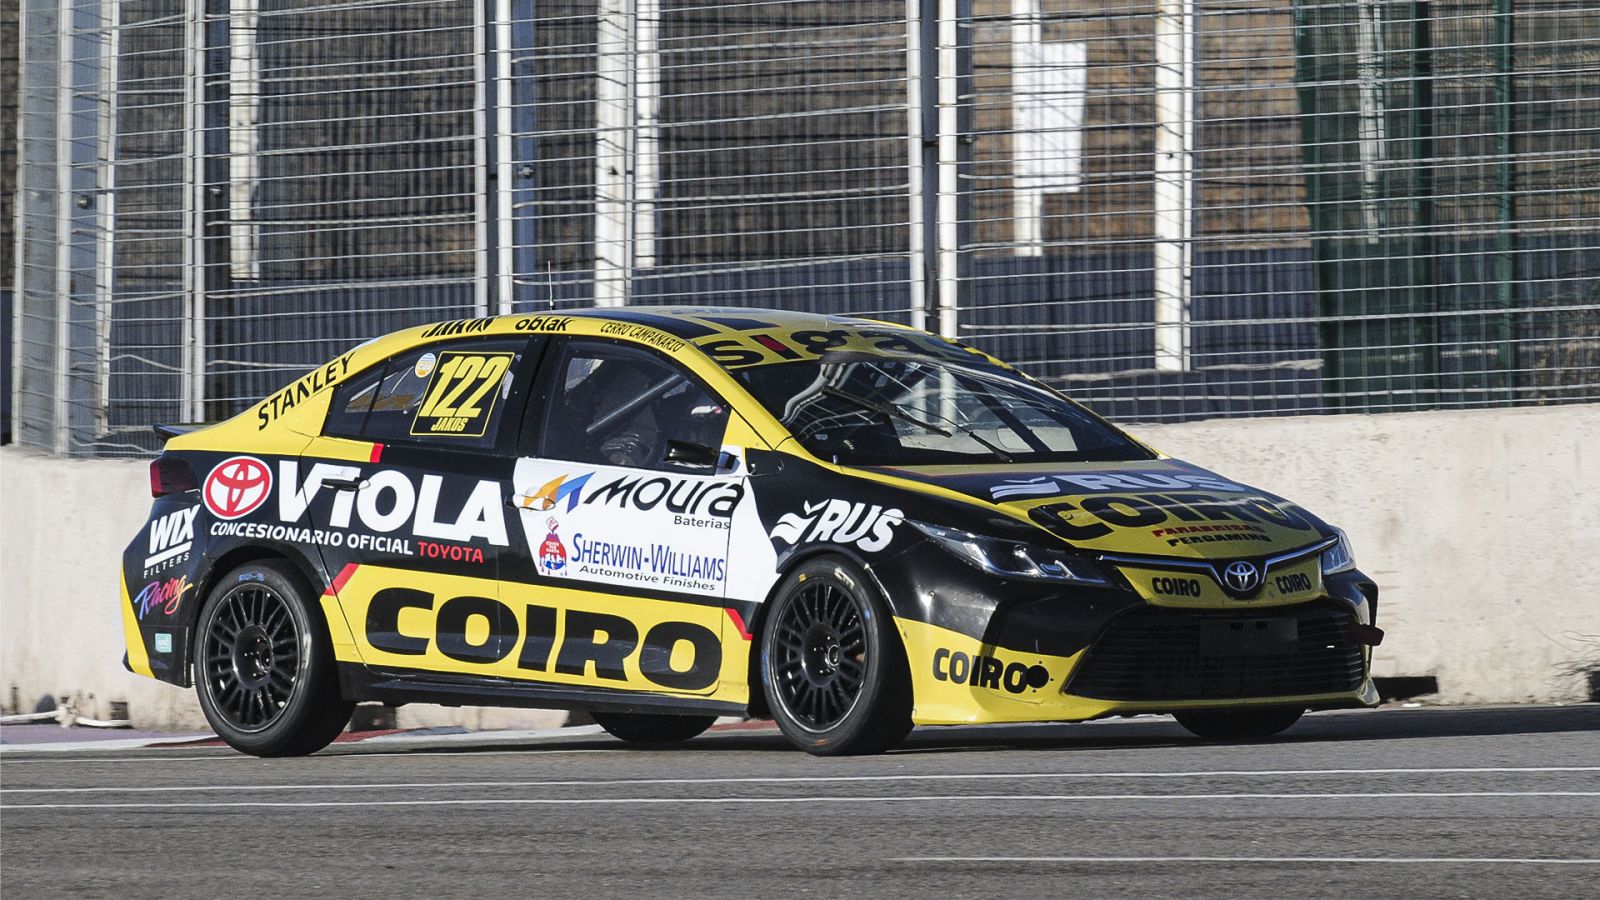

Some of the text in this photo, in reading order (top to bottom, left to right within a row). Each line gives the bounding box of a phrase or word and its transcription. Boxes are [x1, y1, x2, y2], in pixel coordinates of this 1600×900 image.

[515, 317, 573, 332] oblak
[600, 322, 685, 353] CERRO CAMPANARIO
[258, 352, 355, 431] STANLEY
[419, 356, 510, 418] 122
[431, 417, 468, 432] JAKOS
[1052, 474, 1247, 492] RUS
[279, 460, 509, 546] VIOLA
[150, 504, 200, 554] WIX
[673, 515, 730, 530] Baterias
[805, 499, 905, 552] RUS
[210, 522, 484, 563] CONCESIONARIO OFICIAL TOYOTA
[144, 552, 190, 579] FILTERS
[579, 565, 716, 591] Automotive Finishes
[1275, 573, 1311, 593] COIRO
[134, 575, 193, 620] Racing
[1151, 577, 1200, 597] COIRO
[365, 588, 722, 691] COIRO
[933, 648, 1031, 694] COIRO
